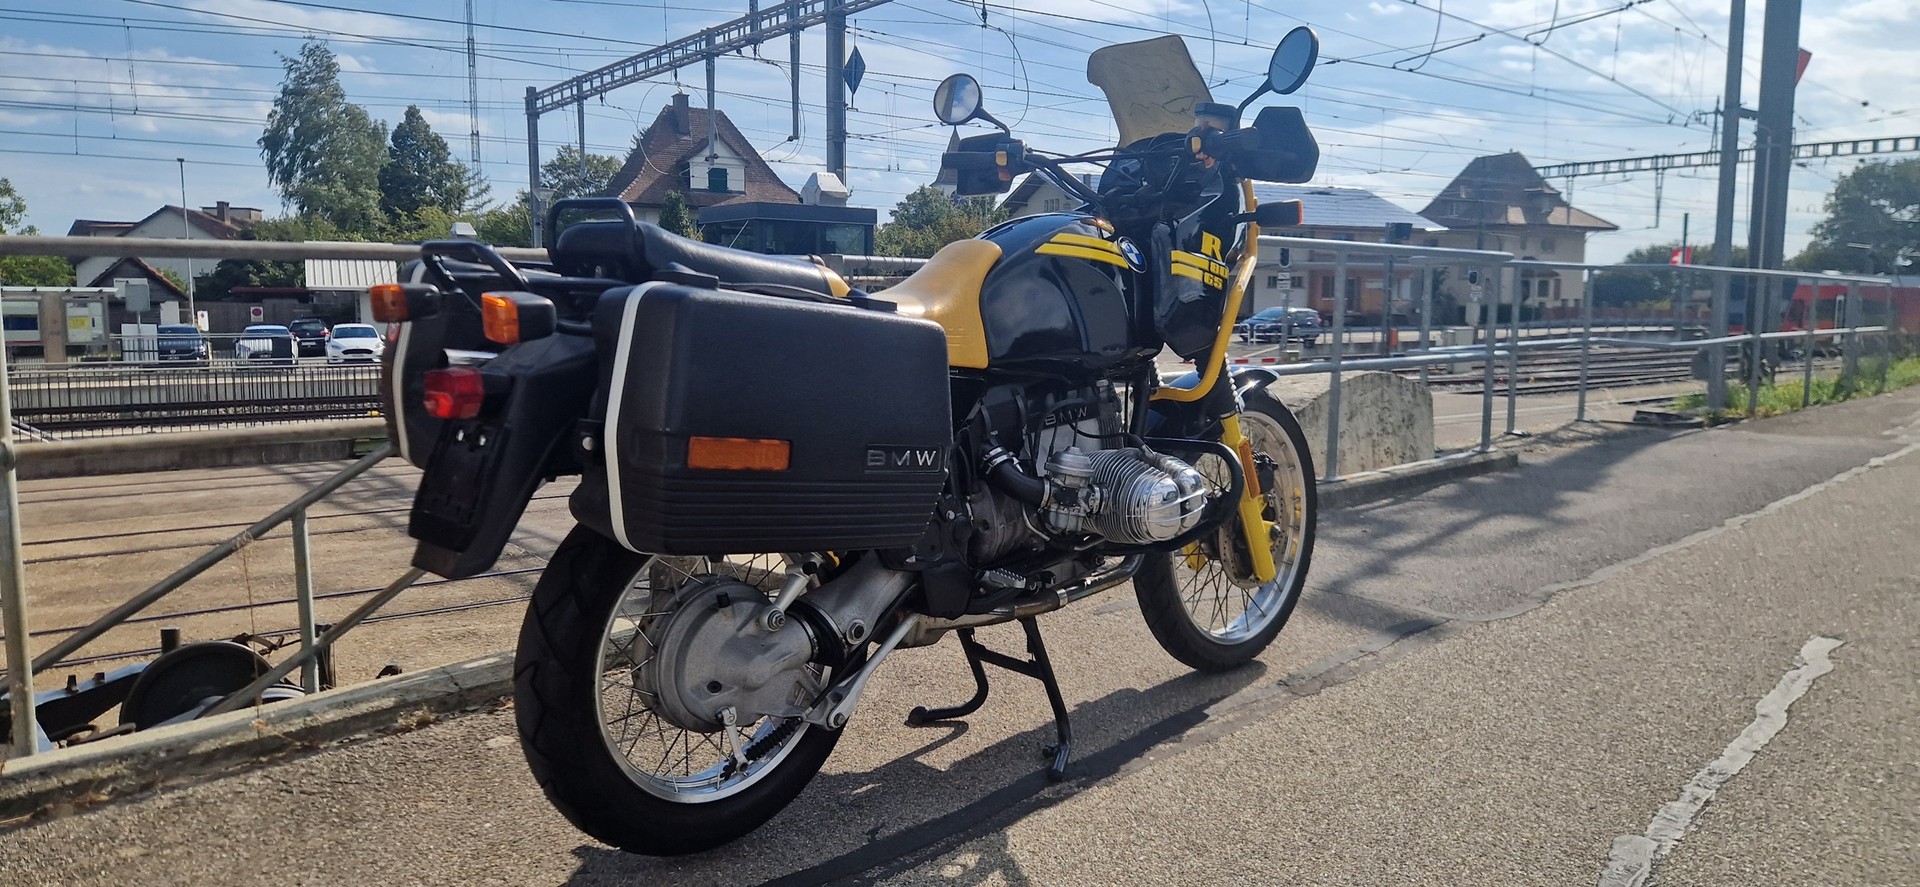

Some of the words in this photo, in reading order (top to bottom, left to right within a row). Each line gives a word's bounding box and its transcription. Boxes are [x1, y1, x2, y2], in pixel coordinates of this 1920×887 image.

[1201, 231, 1222, 262] R
[1210, 261, 1229, 279] 80
[1204, 272, 1223, 290] GS
[1045, 405, 1087, 426] BMW
[867, 450, 936, 466] BMW
